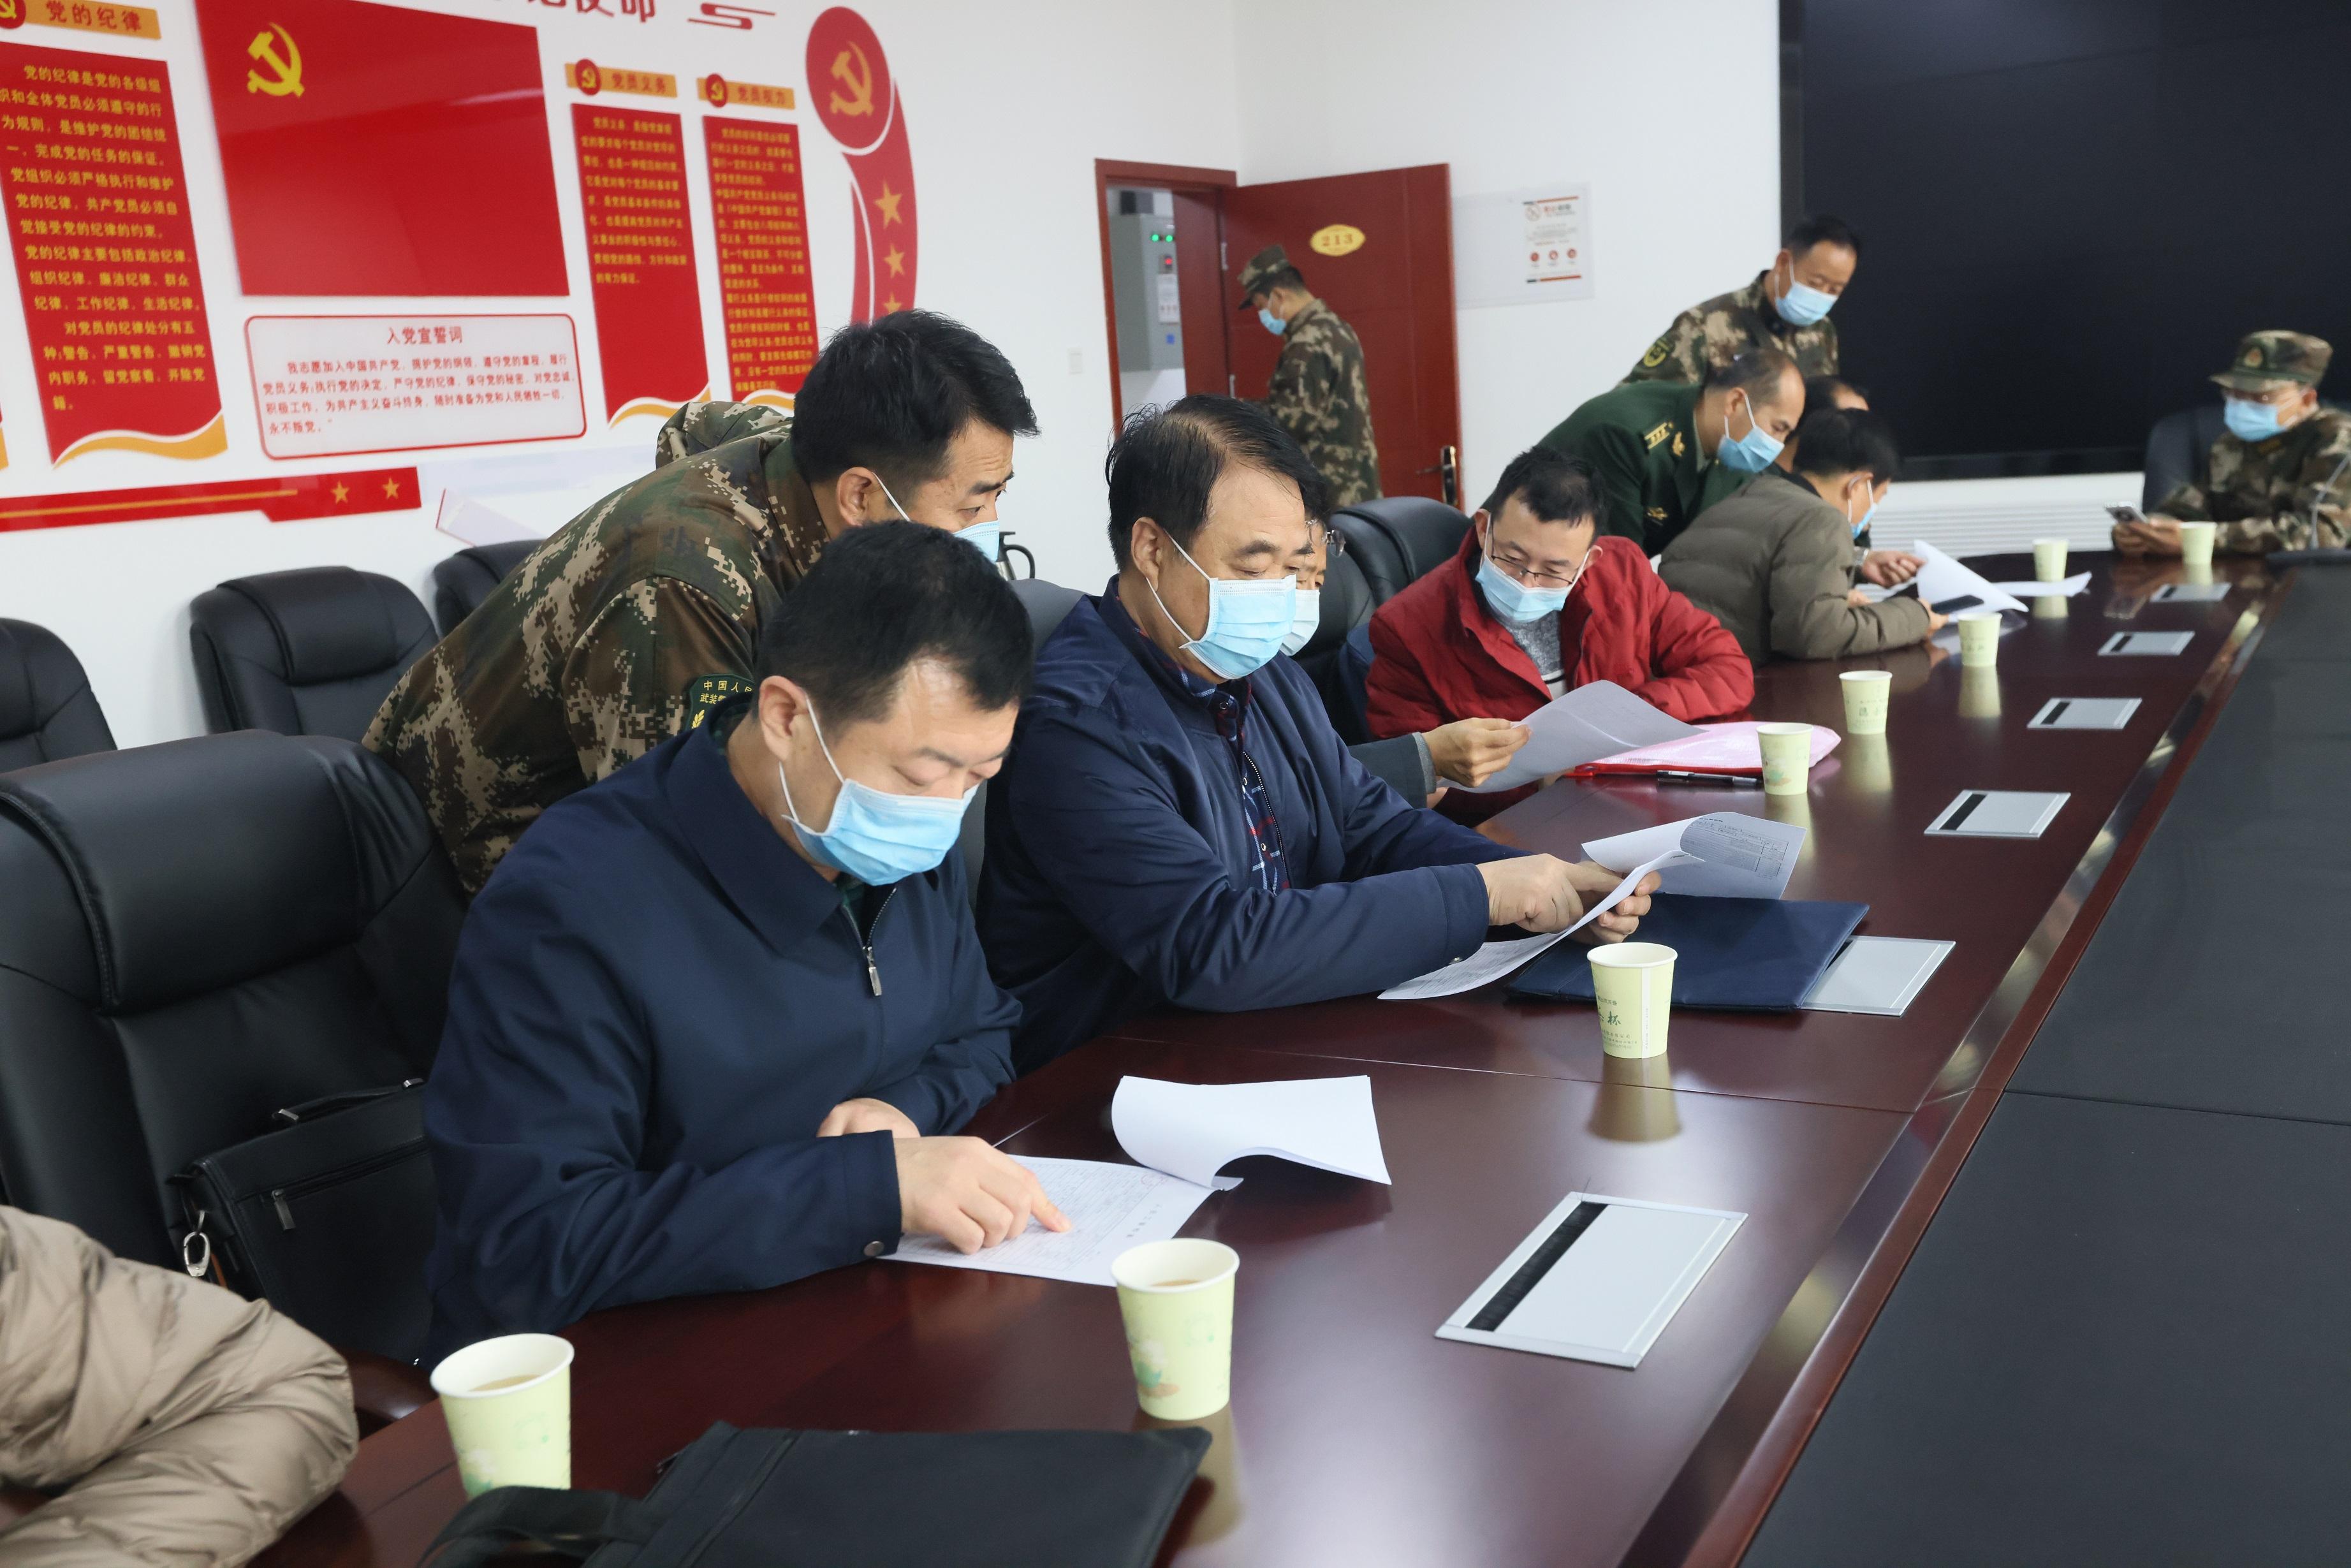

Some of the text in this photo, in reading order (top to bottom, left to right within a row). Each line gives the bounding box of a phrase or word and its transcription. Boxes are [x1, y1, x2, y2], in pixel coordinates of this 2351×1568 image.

[46, 1, 142, 31] 党的纪律
[1321, 233, 1354, 247] 213
[386, 326, 464, 345] 入党宣誓词
